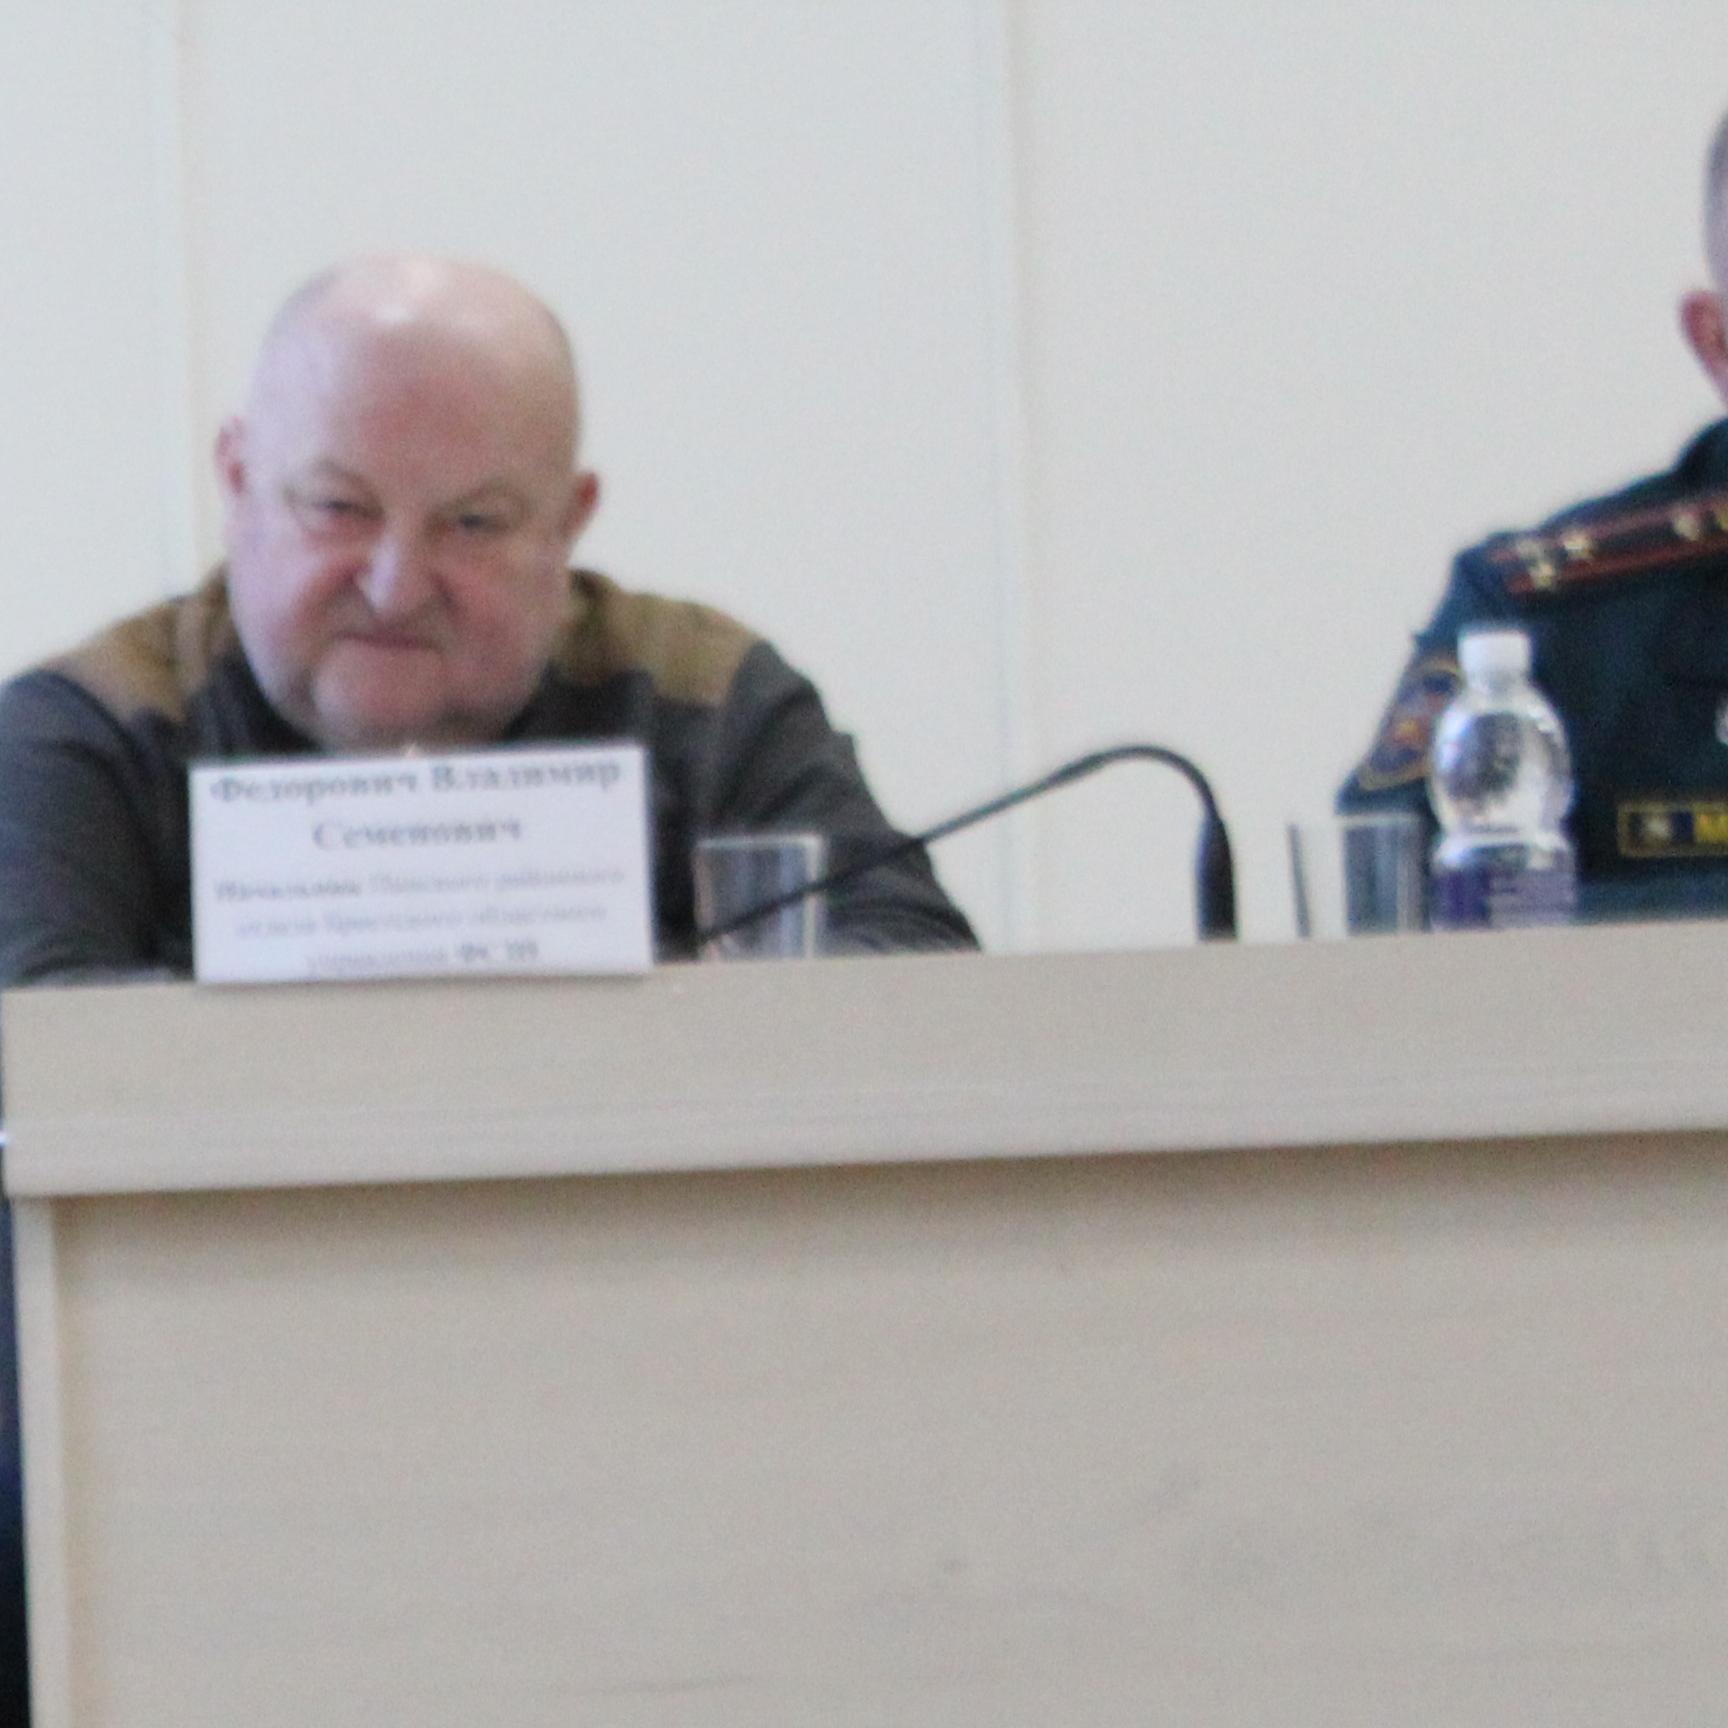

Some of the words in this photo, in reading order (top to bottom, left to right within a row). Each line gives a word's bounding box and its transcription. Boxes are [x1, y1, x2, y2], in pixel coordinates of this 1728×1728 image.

[210, 772, 418, 806] Федорович
[430, 759, 622, 793] Владимир
[312, 816, 522, 850] Семенович
